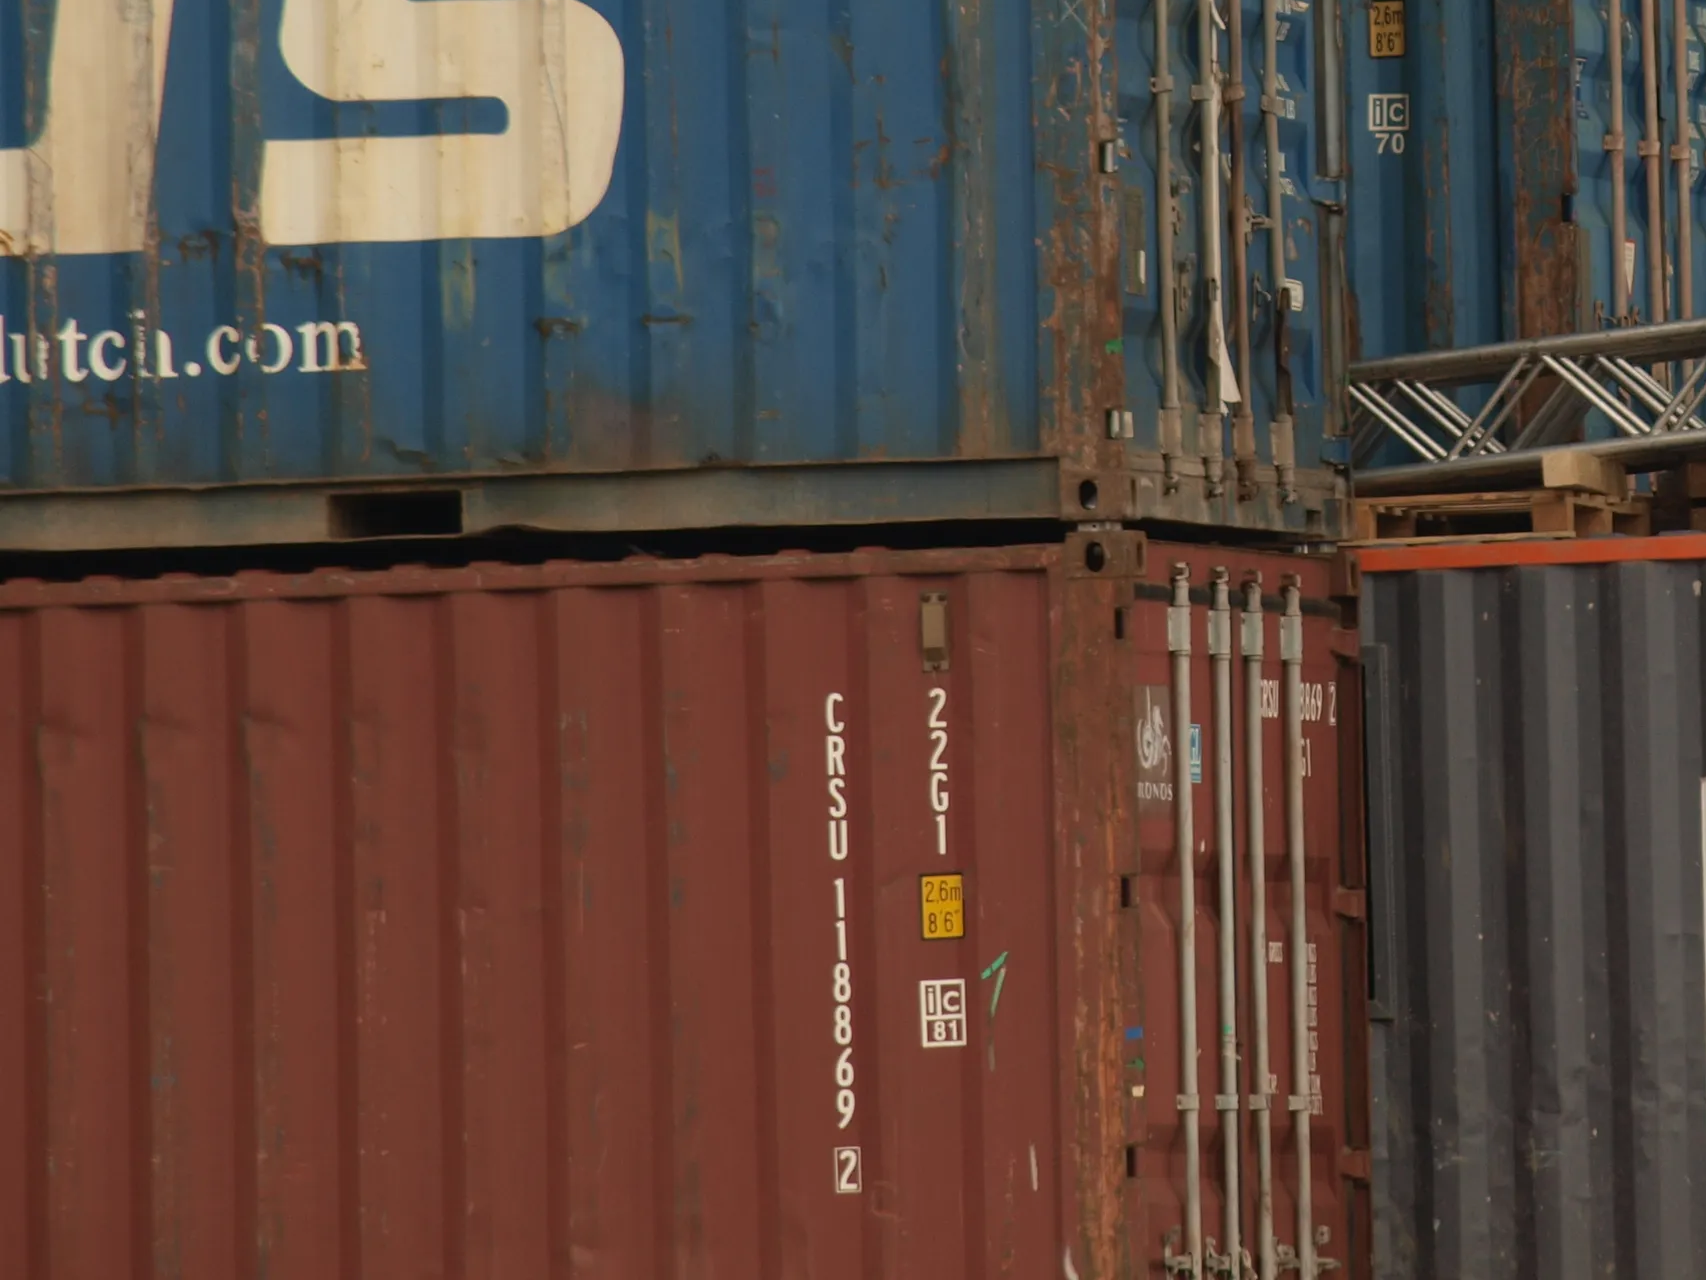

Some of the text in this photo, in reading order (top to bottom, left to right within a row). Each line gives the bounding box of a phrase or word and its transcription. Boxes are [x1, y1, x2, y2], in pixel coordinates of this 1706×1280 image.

[1374, 132, 1405, 155] 70
[0, 308, 368, 384] utch.com
[927, 687, 951, 856] 22G1
[1137, 781, 1174, 802] RONOS
[924, 880, 962, 905] 2,6m
[825, 692, 859, 1193] CRSU 118869 2
[932, 1020, 958, 1042] 81
